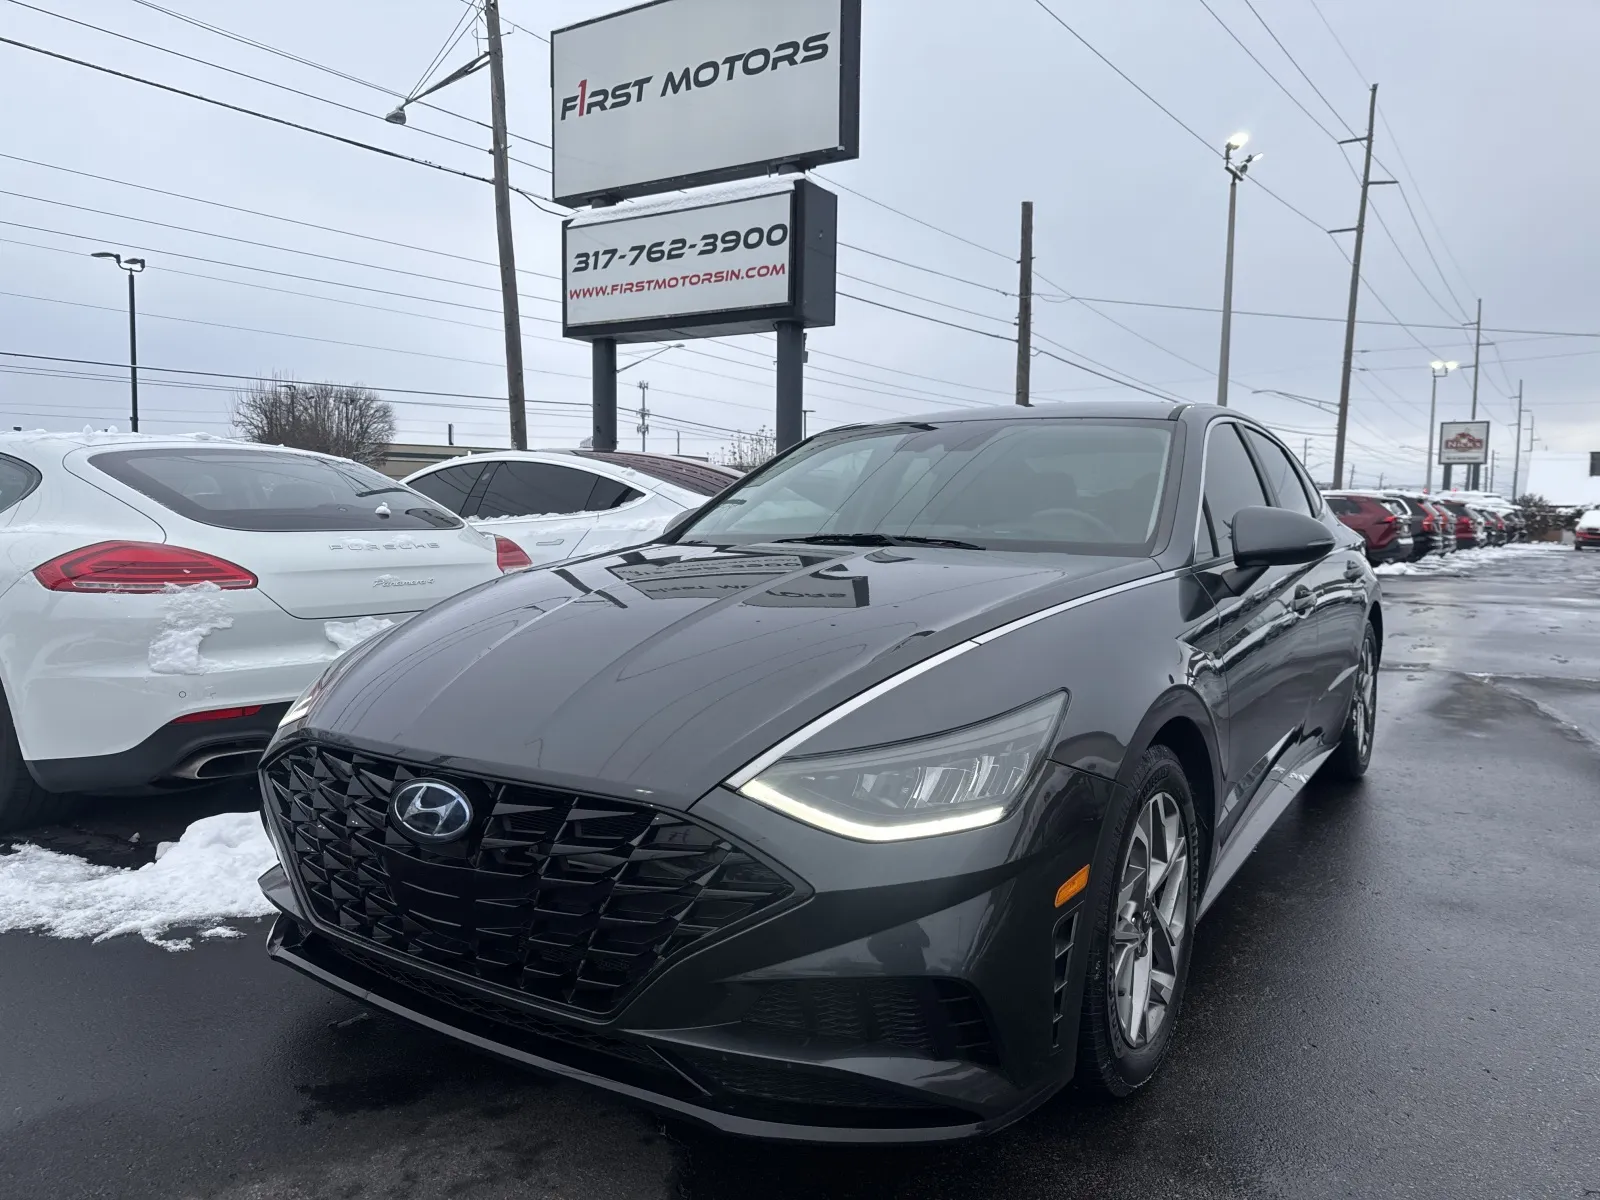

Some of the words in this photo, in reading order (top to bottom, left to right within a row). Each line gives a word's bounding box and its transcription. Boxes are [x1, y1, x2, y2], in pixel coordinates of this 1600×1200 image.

[660, 32, 831, 97] MOTORS
[572, 223, 788, 273] 317-762-3900
[569, 263, 786, 300] WWW.FIRSTMOTORSIN.COM
[329, 543, 440, 551] PORSCHE
